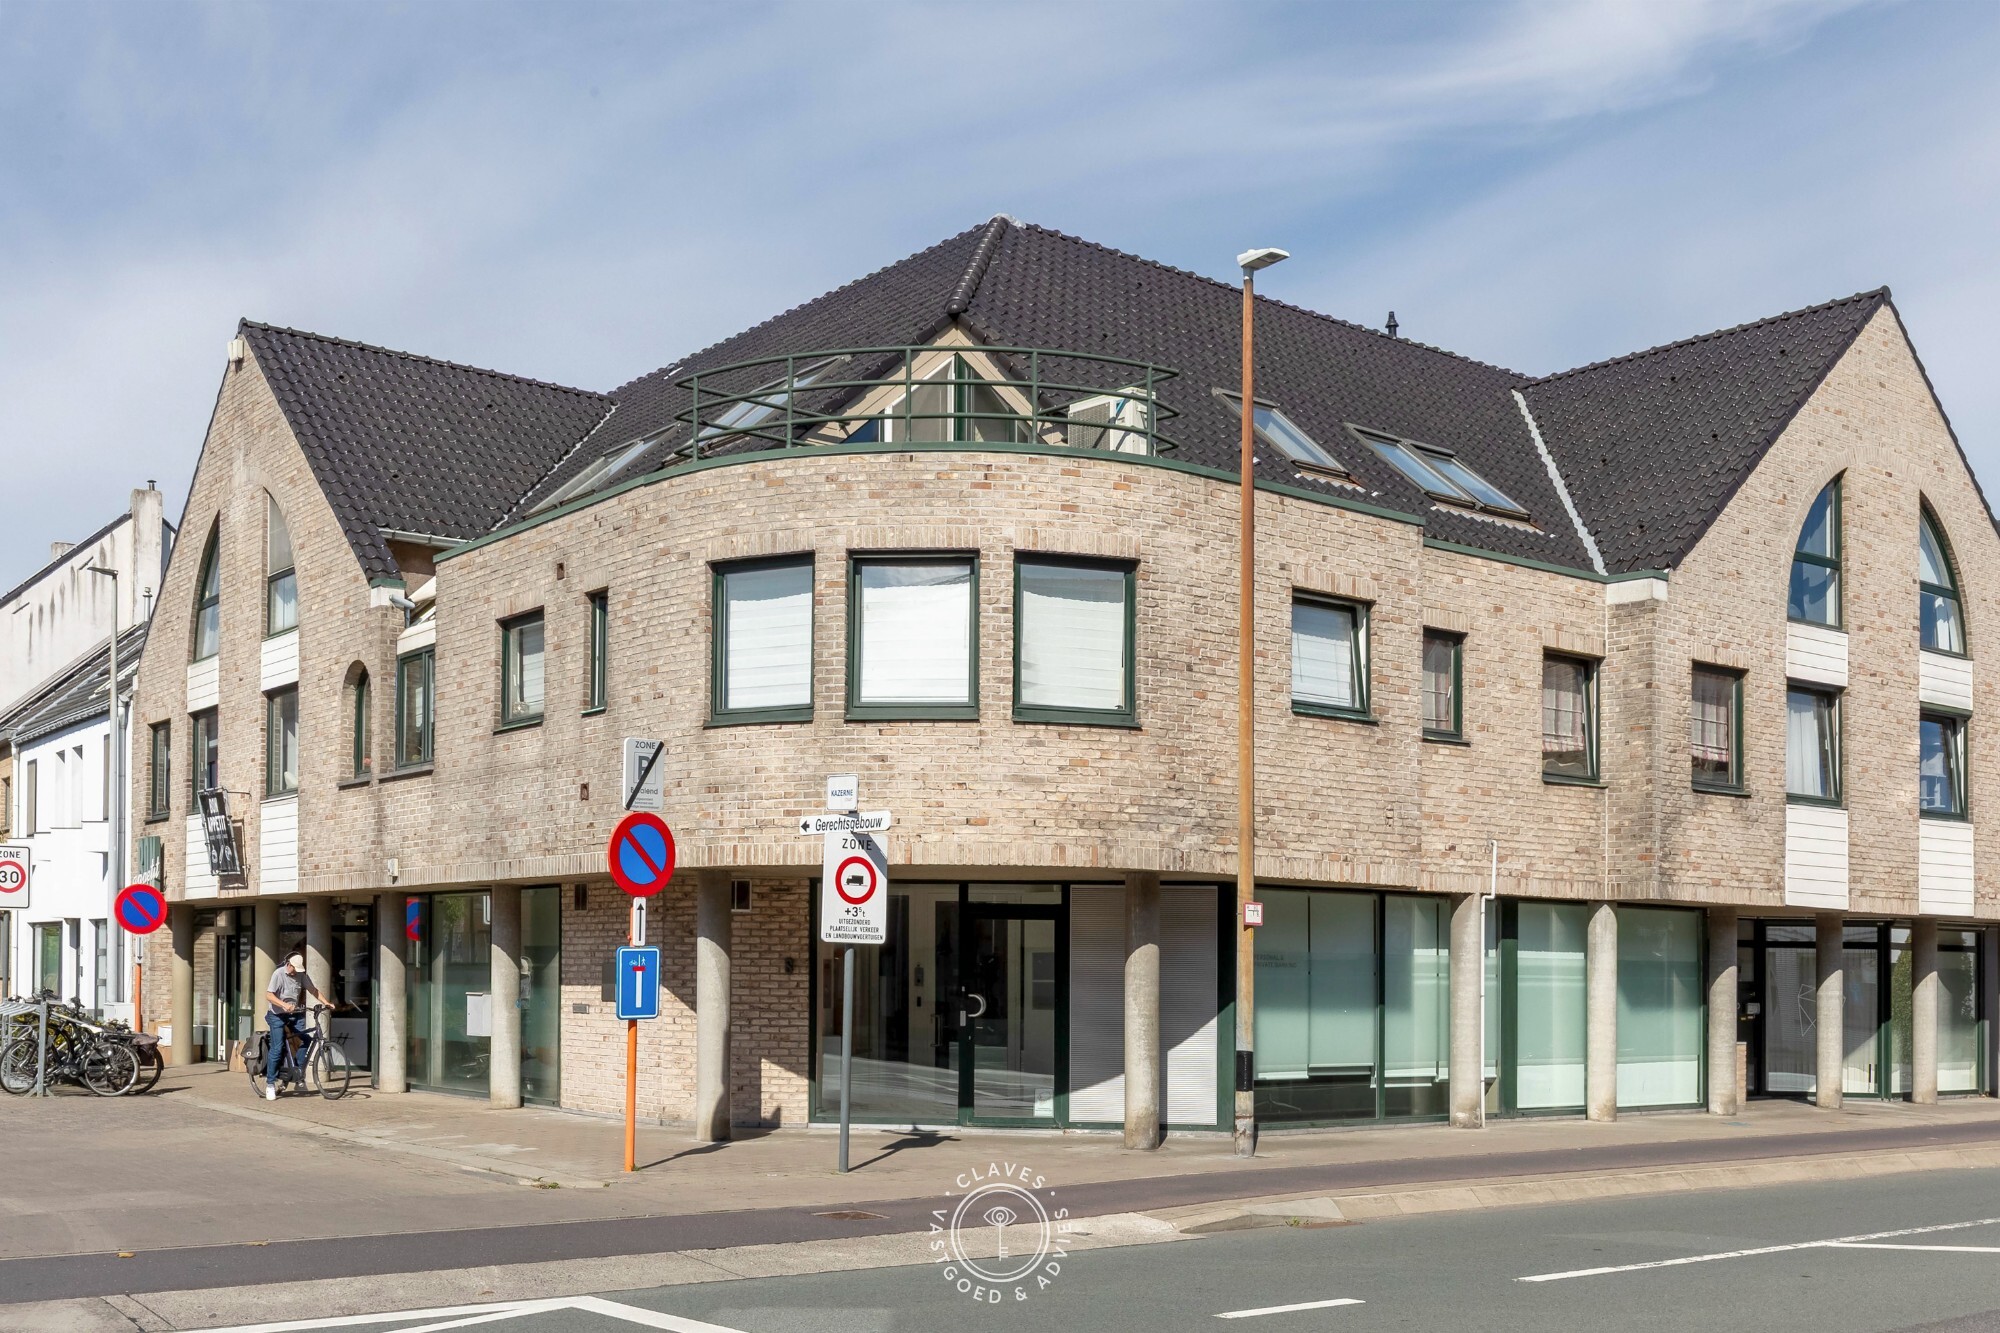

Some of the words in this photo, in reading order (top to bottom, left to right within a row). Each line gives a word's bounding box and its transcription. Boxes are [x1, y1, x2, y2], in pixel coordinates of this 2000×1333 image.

[635, 741, 656, 749] ZONE
[638, 755, 652, 780] P
[630, 787, 659, 795] Balend
[831, 789, 853, 797] KAZERNE
[815, 815, 883, 832] Gerechtsgebouw
[842, 838, 872, 851] ZONE
[0, 870, 19, 883] 30
[833, 932, 883, 940] LANDBOUWVOERTUIGEN
